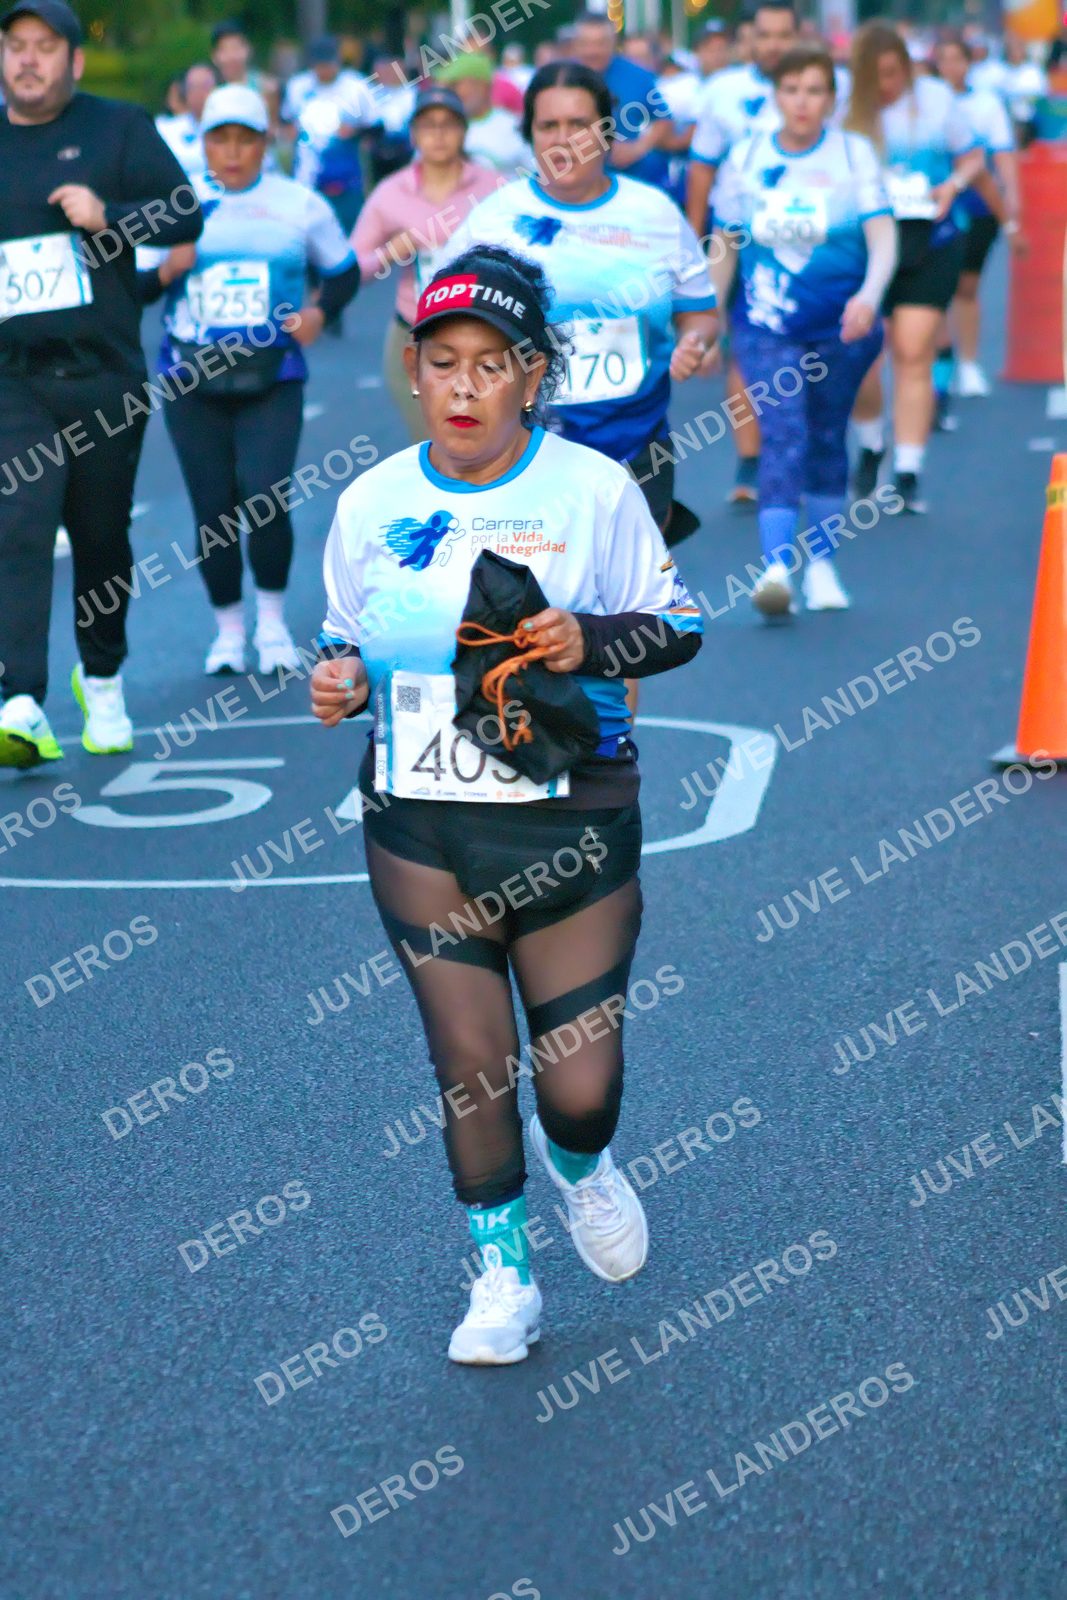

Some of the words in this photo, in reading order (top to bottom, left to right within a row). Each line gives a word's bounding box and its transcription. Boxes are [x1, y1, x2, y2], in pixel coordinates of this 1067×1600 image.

[5, 266, 65, 305] 507
[425, 283, 527, 320] TOPTIME
[472, 517, 543, 531] Carrera
[471, 533, 494, 545] por
[496, 531, 508, 543] la
[512, 531, 544, 543] Vida
[496, 540, 567, 557] Integridad
[71, 757, 285, 829] 5
